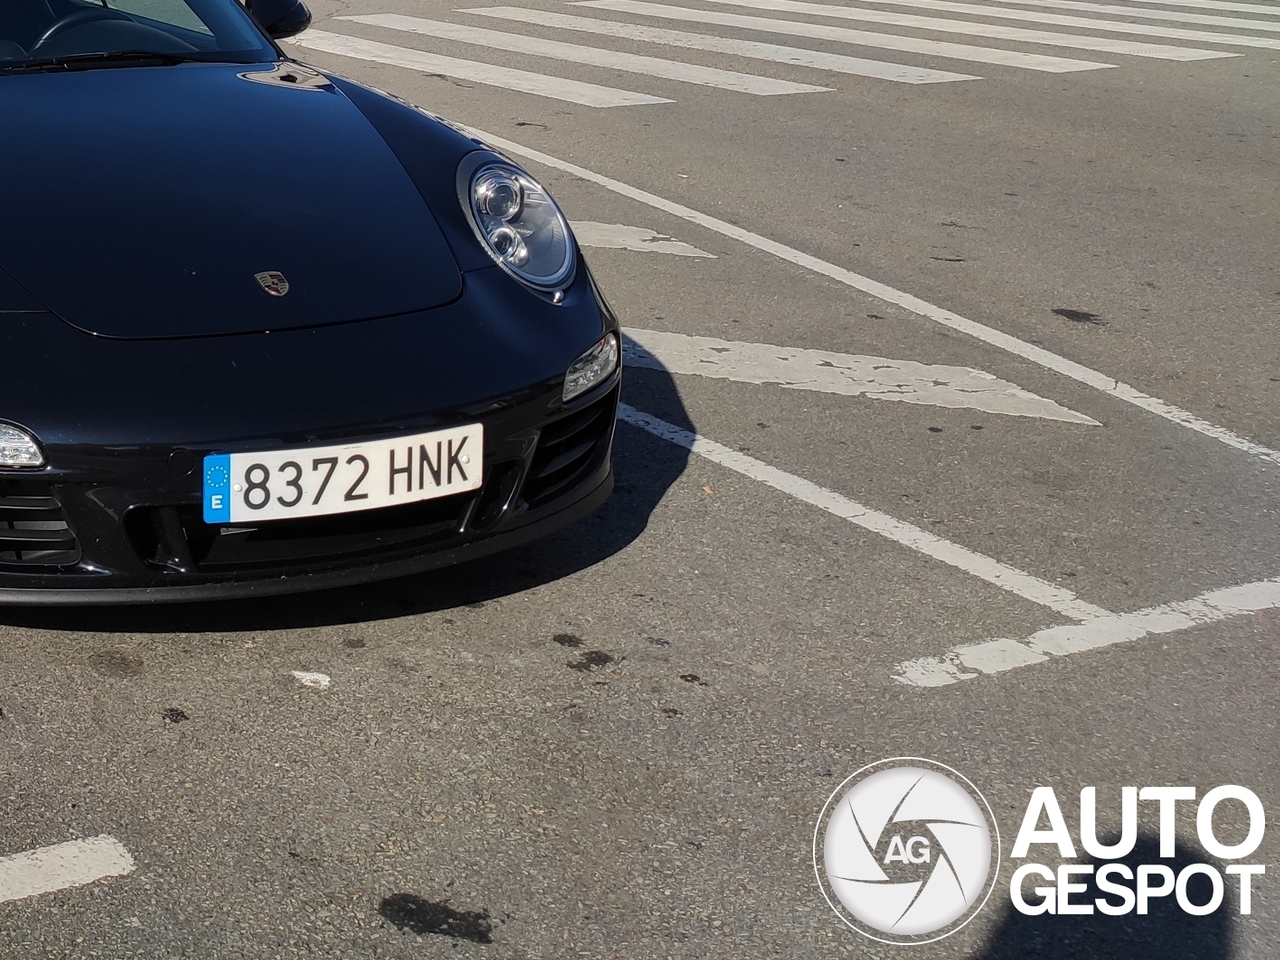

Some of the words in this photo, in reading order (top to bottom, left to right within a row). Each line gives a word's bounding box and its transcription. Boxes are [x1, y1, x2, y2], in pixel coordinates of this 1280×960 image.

[243, 454, 370, 510] 8372
[389, 436, 469, 496] HNK
[211, 495, 223, 509] E
